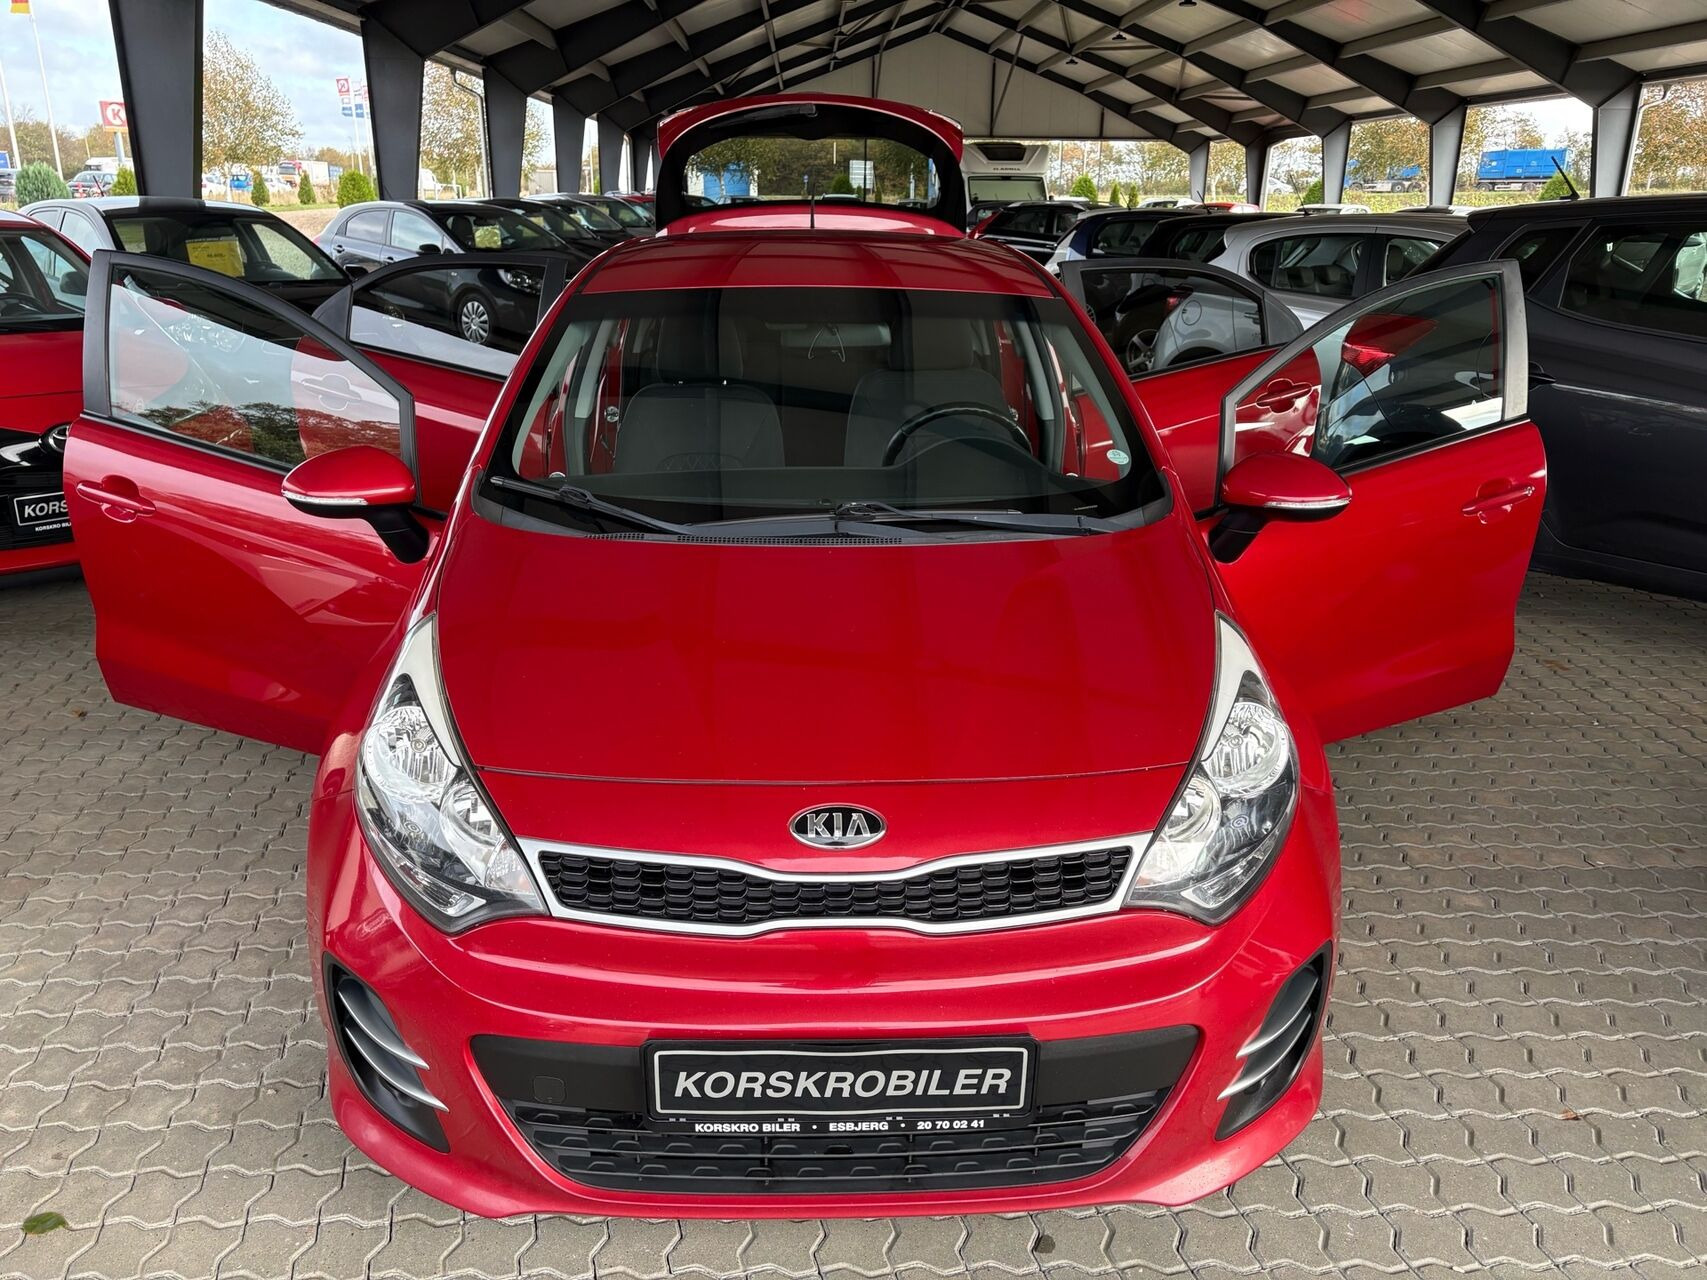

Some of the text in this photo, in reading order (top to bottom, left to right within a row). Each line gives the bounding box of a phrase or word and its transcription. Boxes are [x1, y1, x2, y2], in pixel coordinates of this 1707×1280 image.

[111, 108, 124, 122] K
[806, 812, 871, 840] KIA
[674, 1069, 1012, 1098] KORSKROBILER
[694, 1119, 985, 1133] KORSKRO BILER ESBJERG 20 70 02 41
